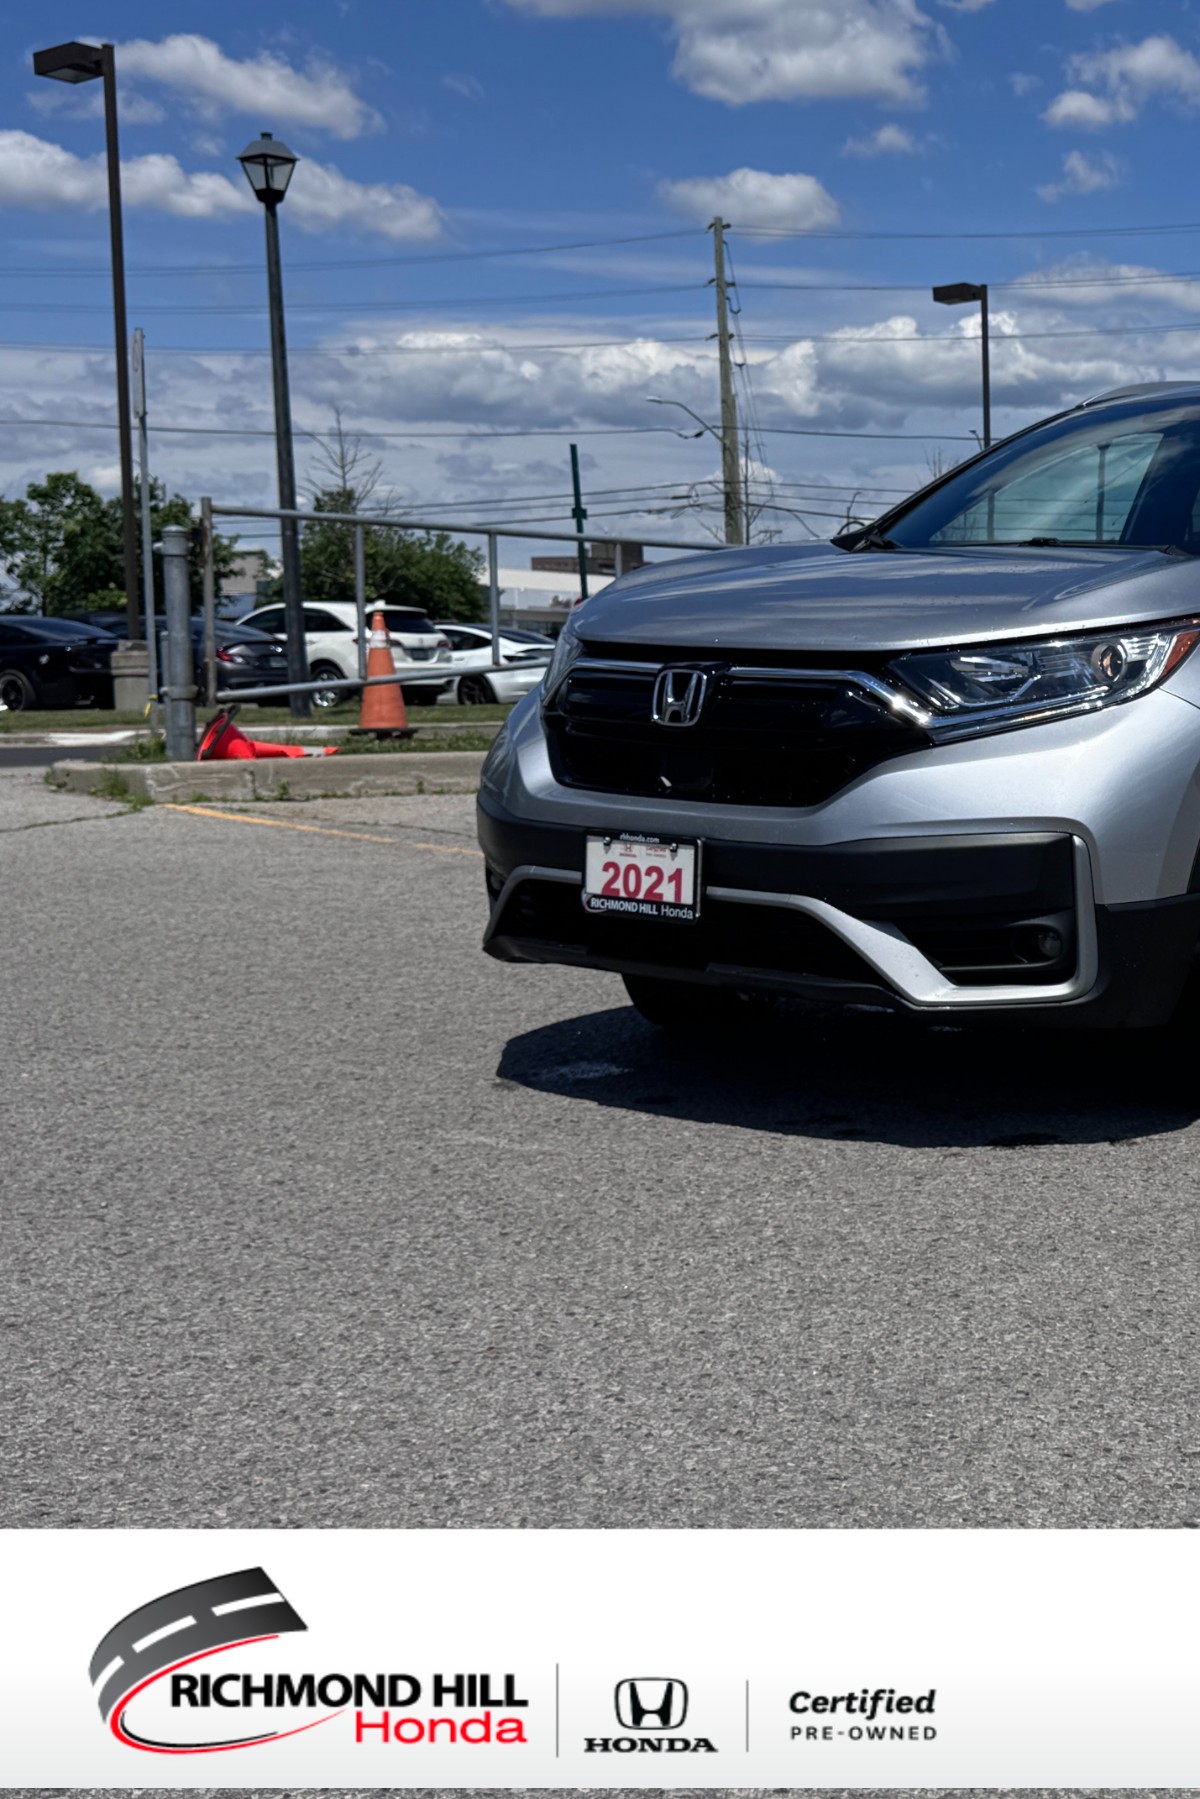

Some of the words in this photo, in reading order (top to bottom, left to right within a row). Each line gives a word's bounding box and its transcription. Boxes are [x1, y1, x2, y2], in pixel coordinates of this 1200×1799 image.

[602, 861, 683, 905] 2021
[590, 897, 638, 914] RICHMOND
[639, 902, 659, 915] HILL
[661, 905, 694, 920] Honda
